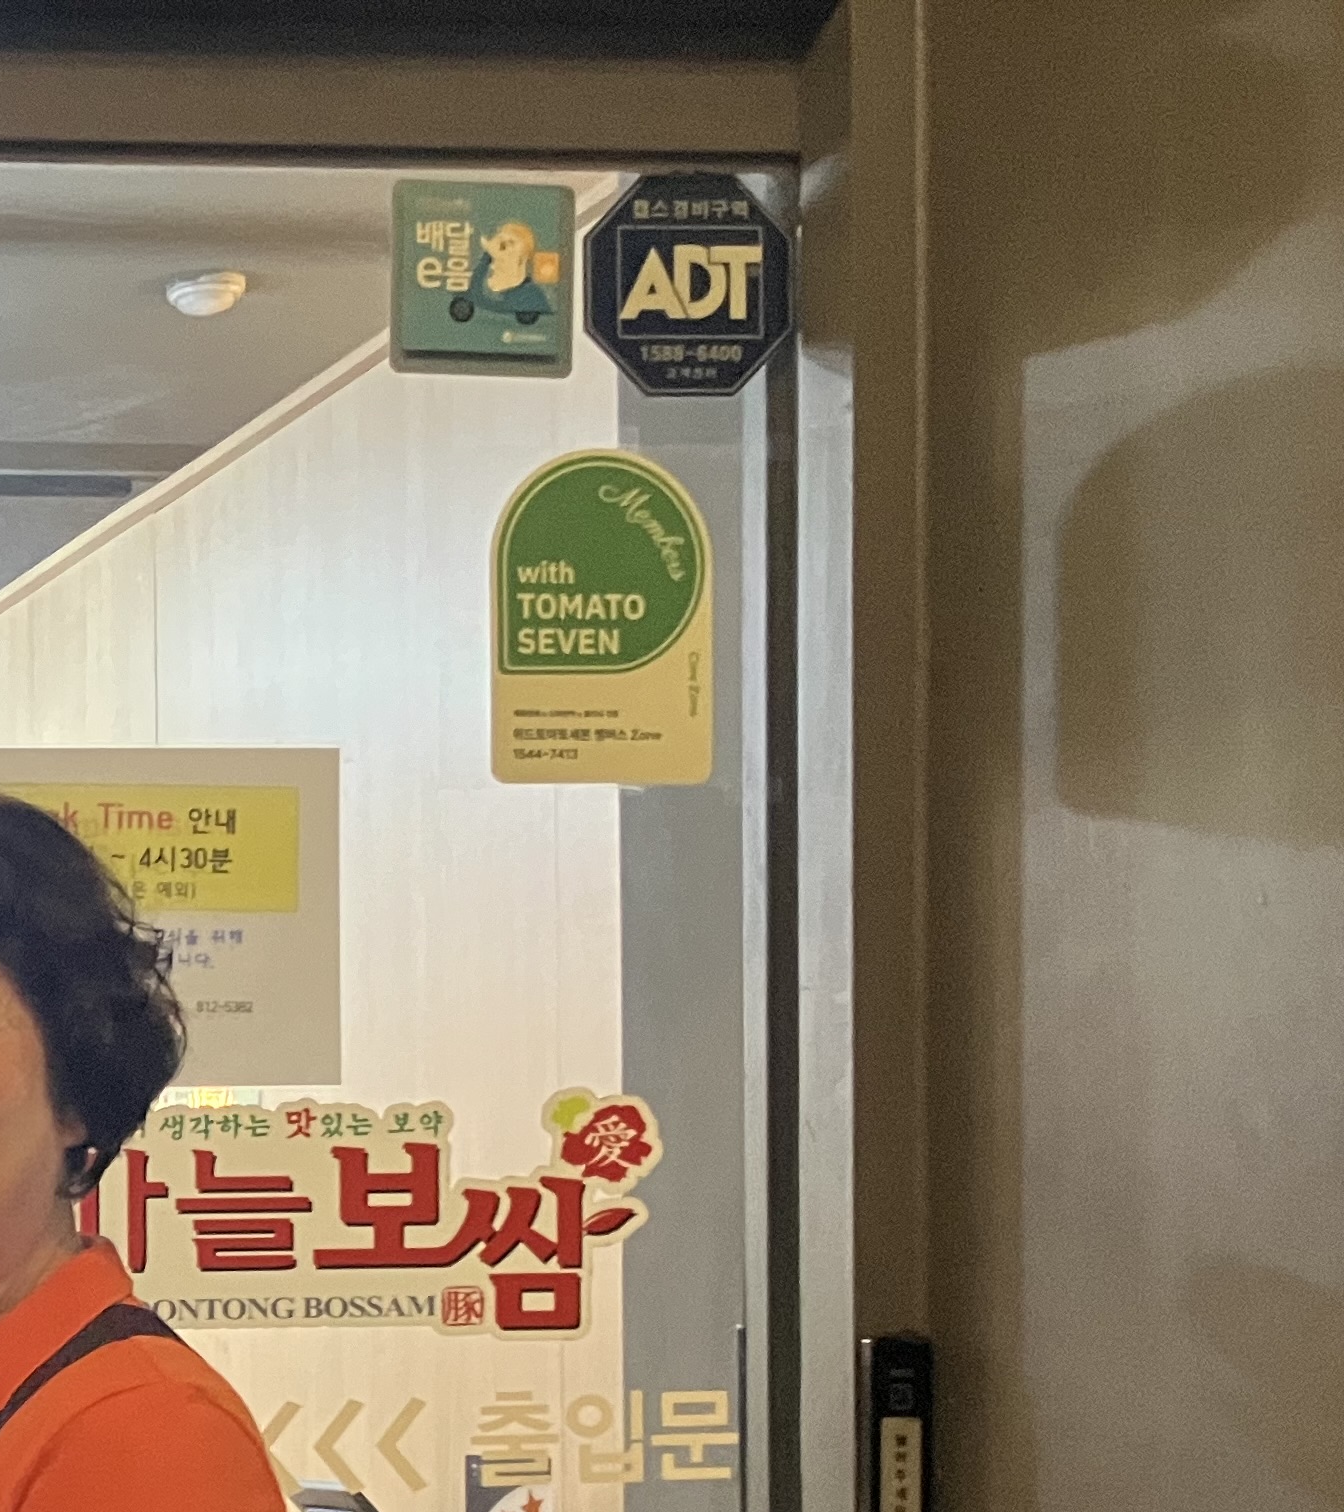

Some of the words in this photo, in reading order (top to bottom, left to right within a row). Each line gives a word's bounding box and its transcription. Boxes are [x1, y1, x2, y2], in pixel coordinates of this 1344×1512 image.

[619, 244, 762, 320] ADT
[517, 561, 575, 584] with
[517, 593, 645, 620] TOMATO
[518, 628, 620, 655] SEVEN
[97, 803, 175, 831] Time
[188, 808, 237, 834] 안내
[139, 848, 232, 873] 4시30분
[159, 1113, 272, 1142] 생각하는
[285, 1108, 374, 1140] 맛있는
[388, 1111, 445, 1136] 보약
[148, 1297, 295, 1322] ONTONG
[303, 1295, 436, 1319] BOSSAM
[470, 1389, 740, 1488] 출입문
